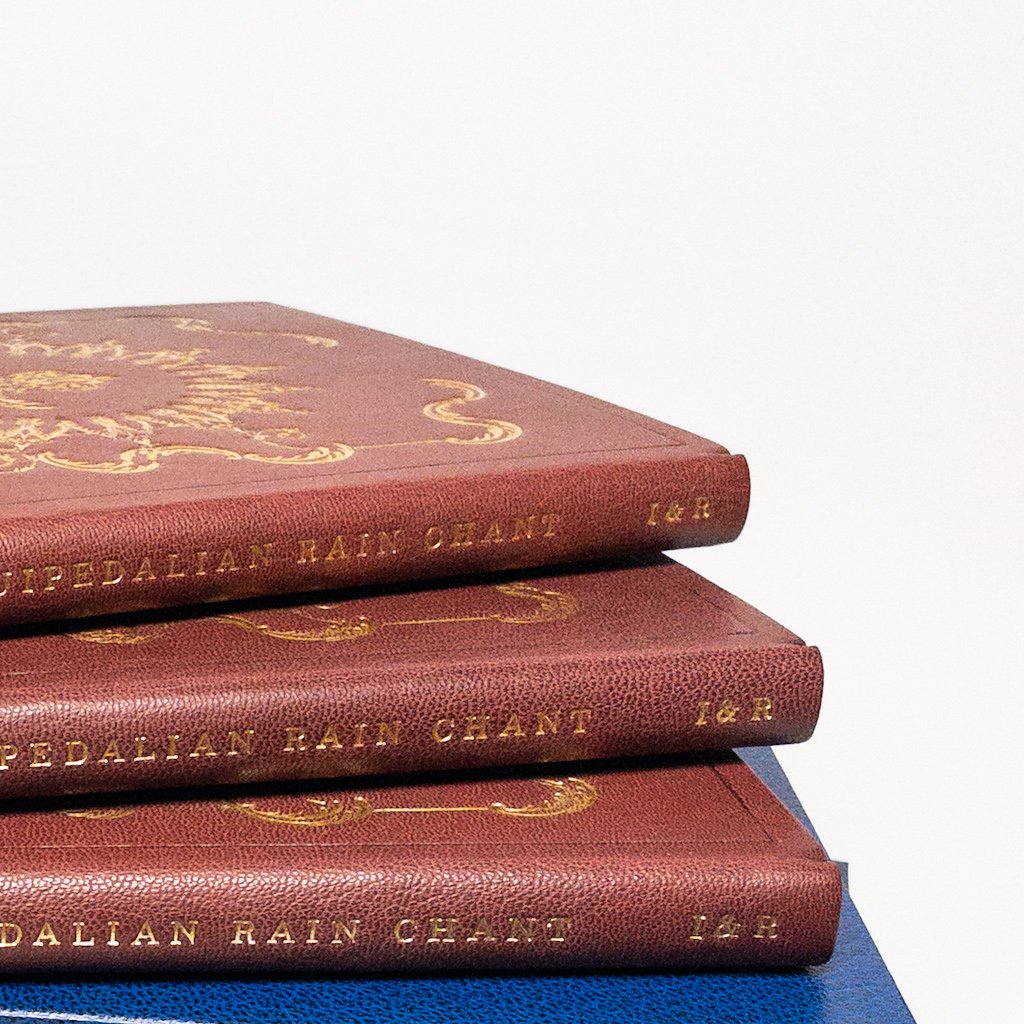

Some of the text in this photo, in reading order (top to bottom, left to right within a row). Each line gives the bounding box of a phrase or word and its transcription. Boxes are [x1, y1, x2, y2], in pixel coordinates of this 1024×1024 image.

[298, 528, 403, 563] RAIN
[426, 512, 558, 549] CHANT
[283, 720, 405, 751] RAIN
[434, 708, 591, 741] CHANT
[232, 920, 360, 944] RAIN
[394, 918, 575, 943] CHANT
